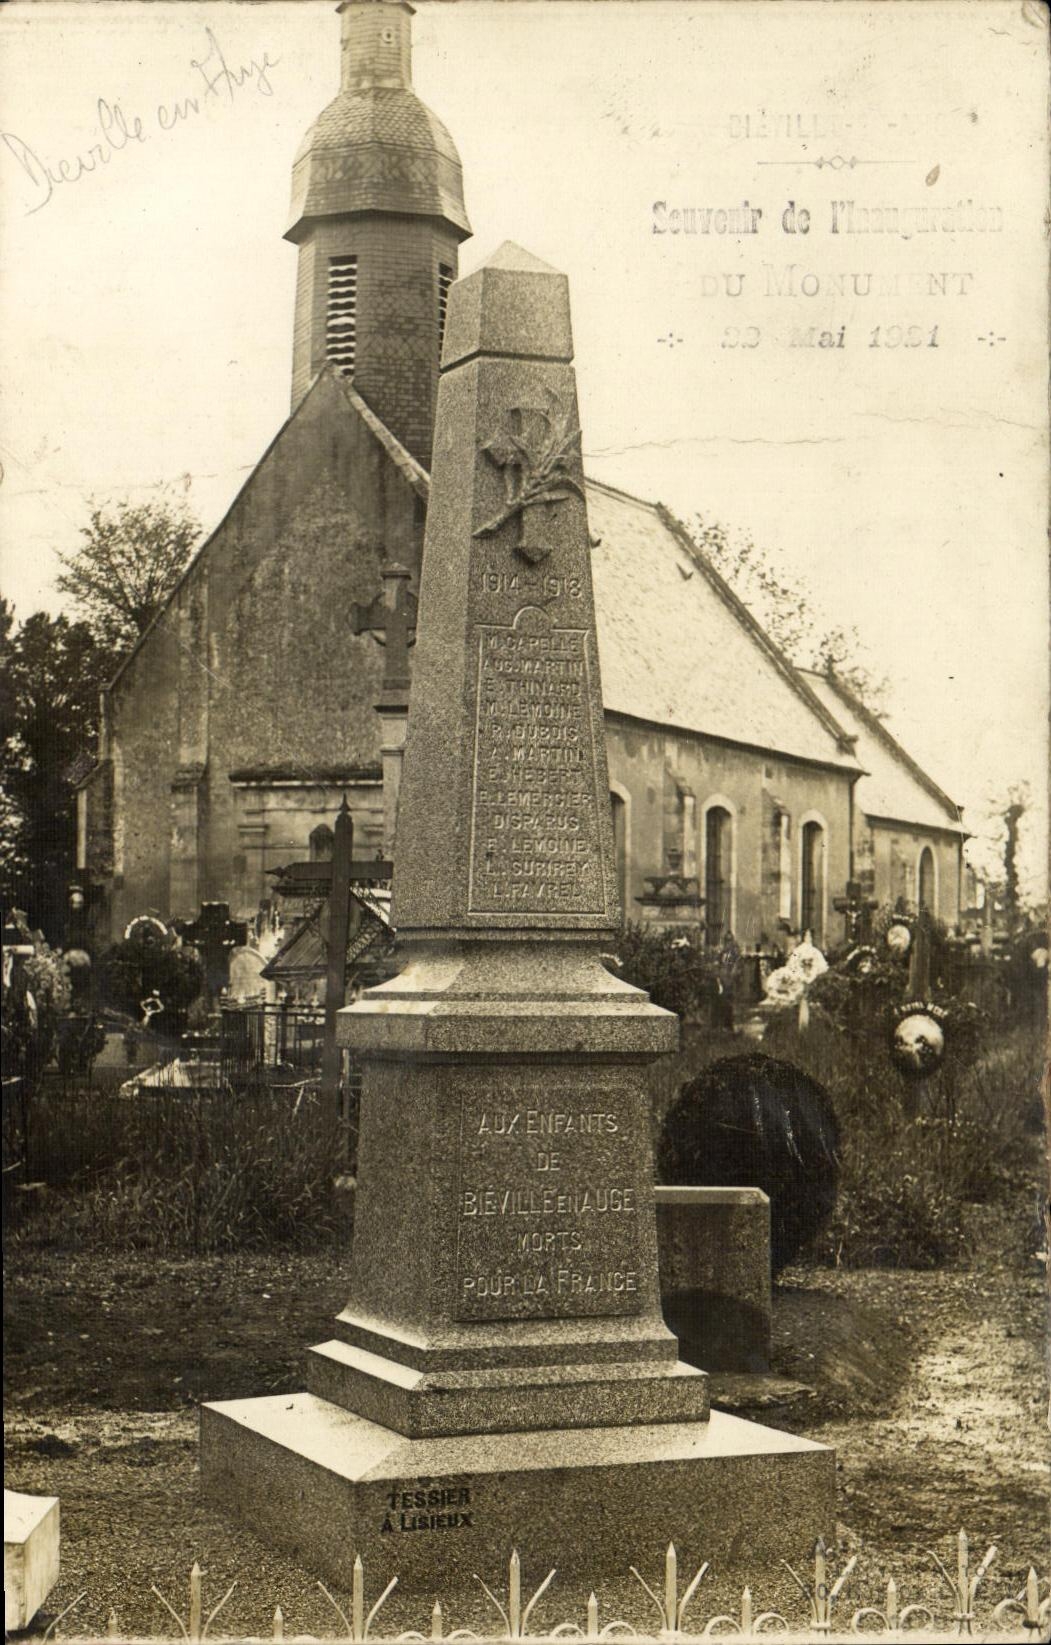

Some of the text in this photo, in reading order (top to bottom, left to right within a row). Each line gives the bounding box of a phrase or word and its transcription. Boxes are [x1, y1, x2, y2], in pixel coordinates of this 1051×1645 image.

[158, 98, 199, 129] en
[477, 1110, 619, 1135] AUX ENFANTS
[537, 1152, 560, 1171] DE
[581, 1189, 634, 1213] AUGE
[517, 1232, 582, 1252] MORTS
[464, 1270, 637, 1297] POUR LA FRANCE
[386, 1488, 471, 1510] TESSIER
[401, 1513, 473, 1530] LISIEUX
